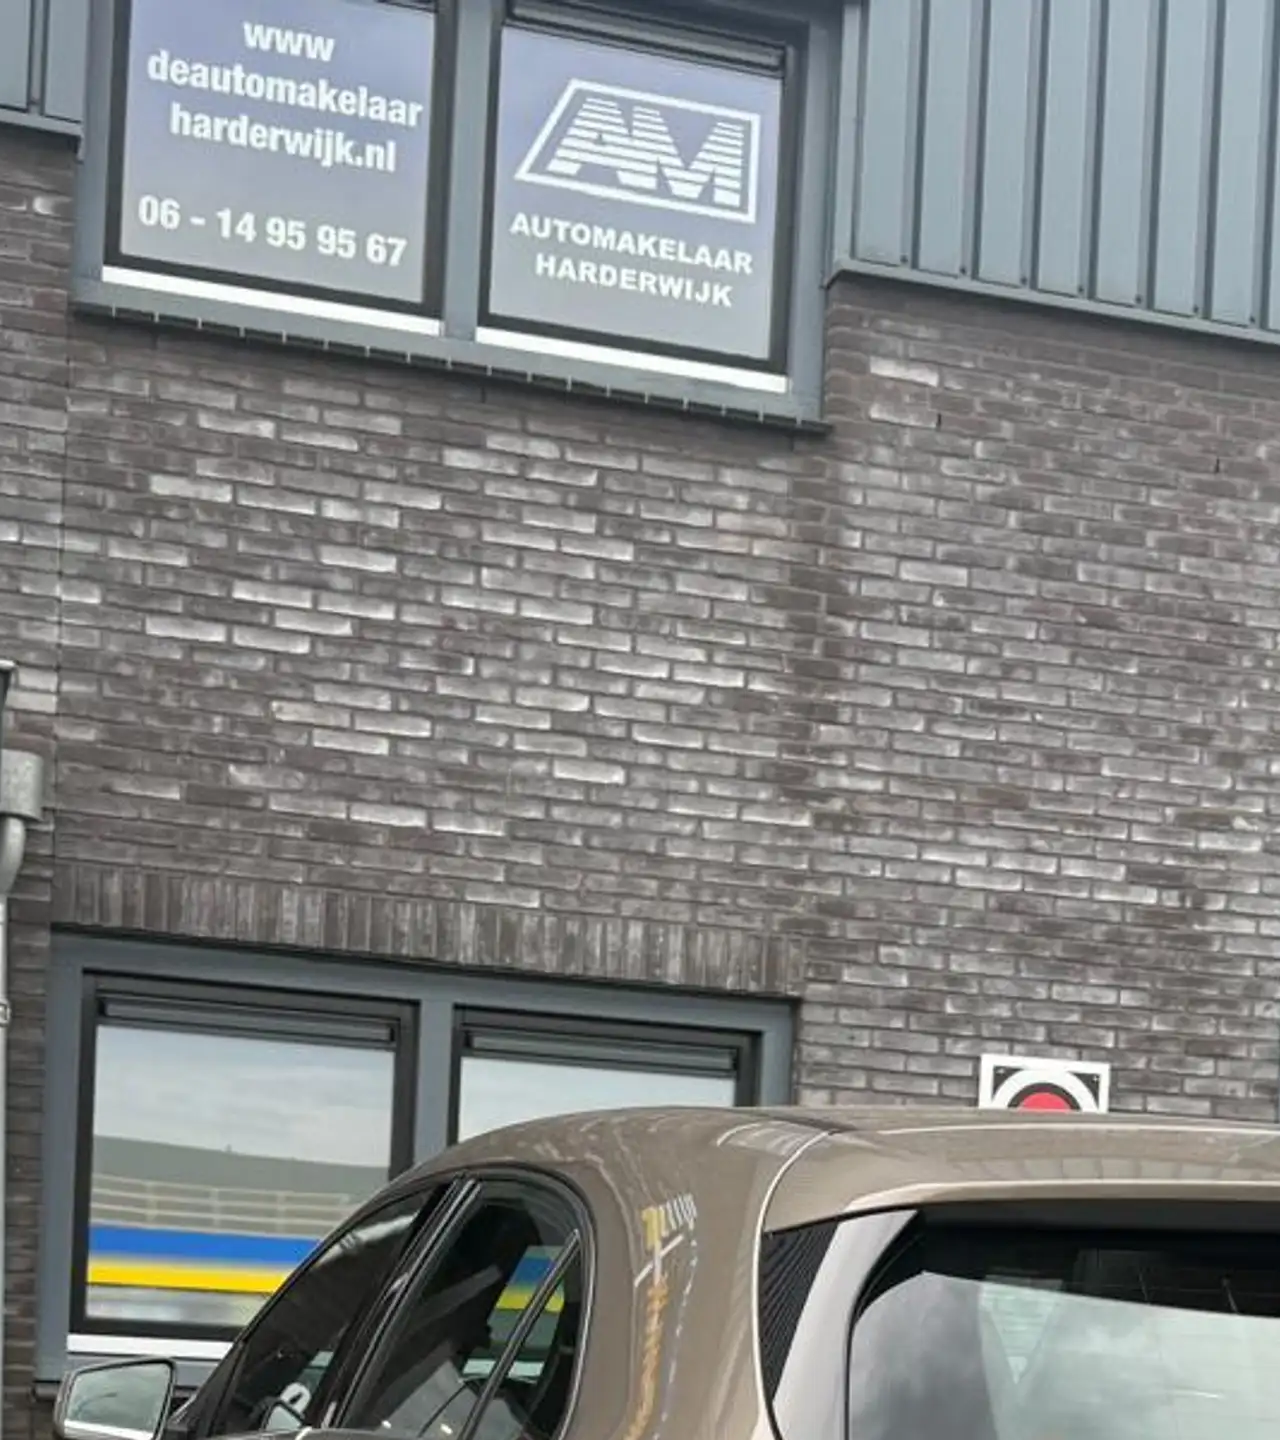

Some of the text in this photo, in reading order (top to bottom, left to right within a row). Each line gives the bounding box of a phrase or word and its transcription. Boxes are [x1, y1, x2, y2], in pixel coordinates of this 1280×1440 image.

[242, 21, 335, 62] www
[147, 49, 423, 127] deautomakelaar
[170, 101, 396, 173] harderwijk.nl
[138, 194, 181, 230] 06
[217, 207, 257, 243] 14
[266, 216, 306, 250] 95
[317, 224, 356, 260] 95
[366, 232, 407, 267] 67
[510, 212, 753, 275] AUTOMAKELAAR
[535, 253, 734, 307] HARDERWIJK
